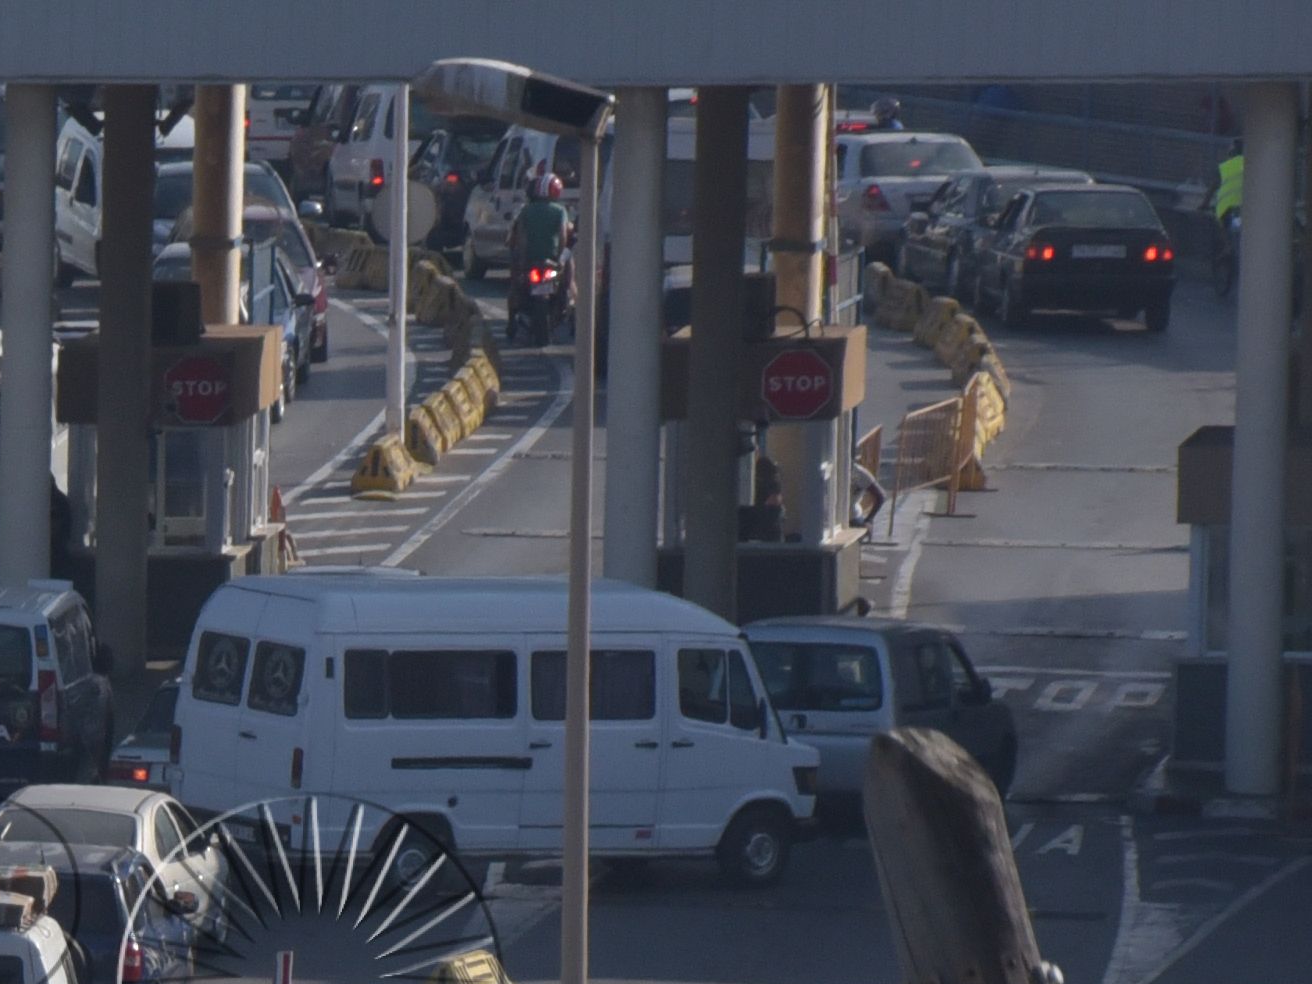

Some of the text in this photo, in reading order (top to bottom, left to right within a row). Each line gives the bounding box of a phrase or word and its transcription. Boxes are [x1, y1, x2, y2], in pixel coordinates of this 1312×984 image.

[171, 379, 228, 397] STOP
[768, 374, 827, 393] STOP
[990, 676, 1168, 712] TOP
